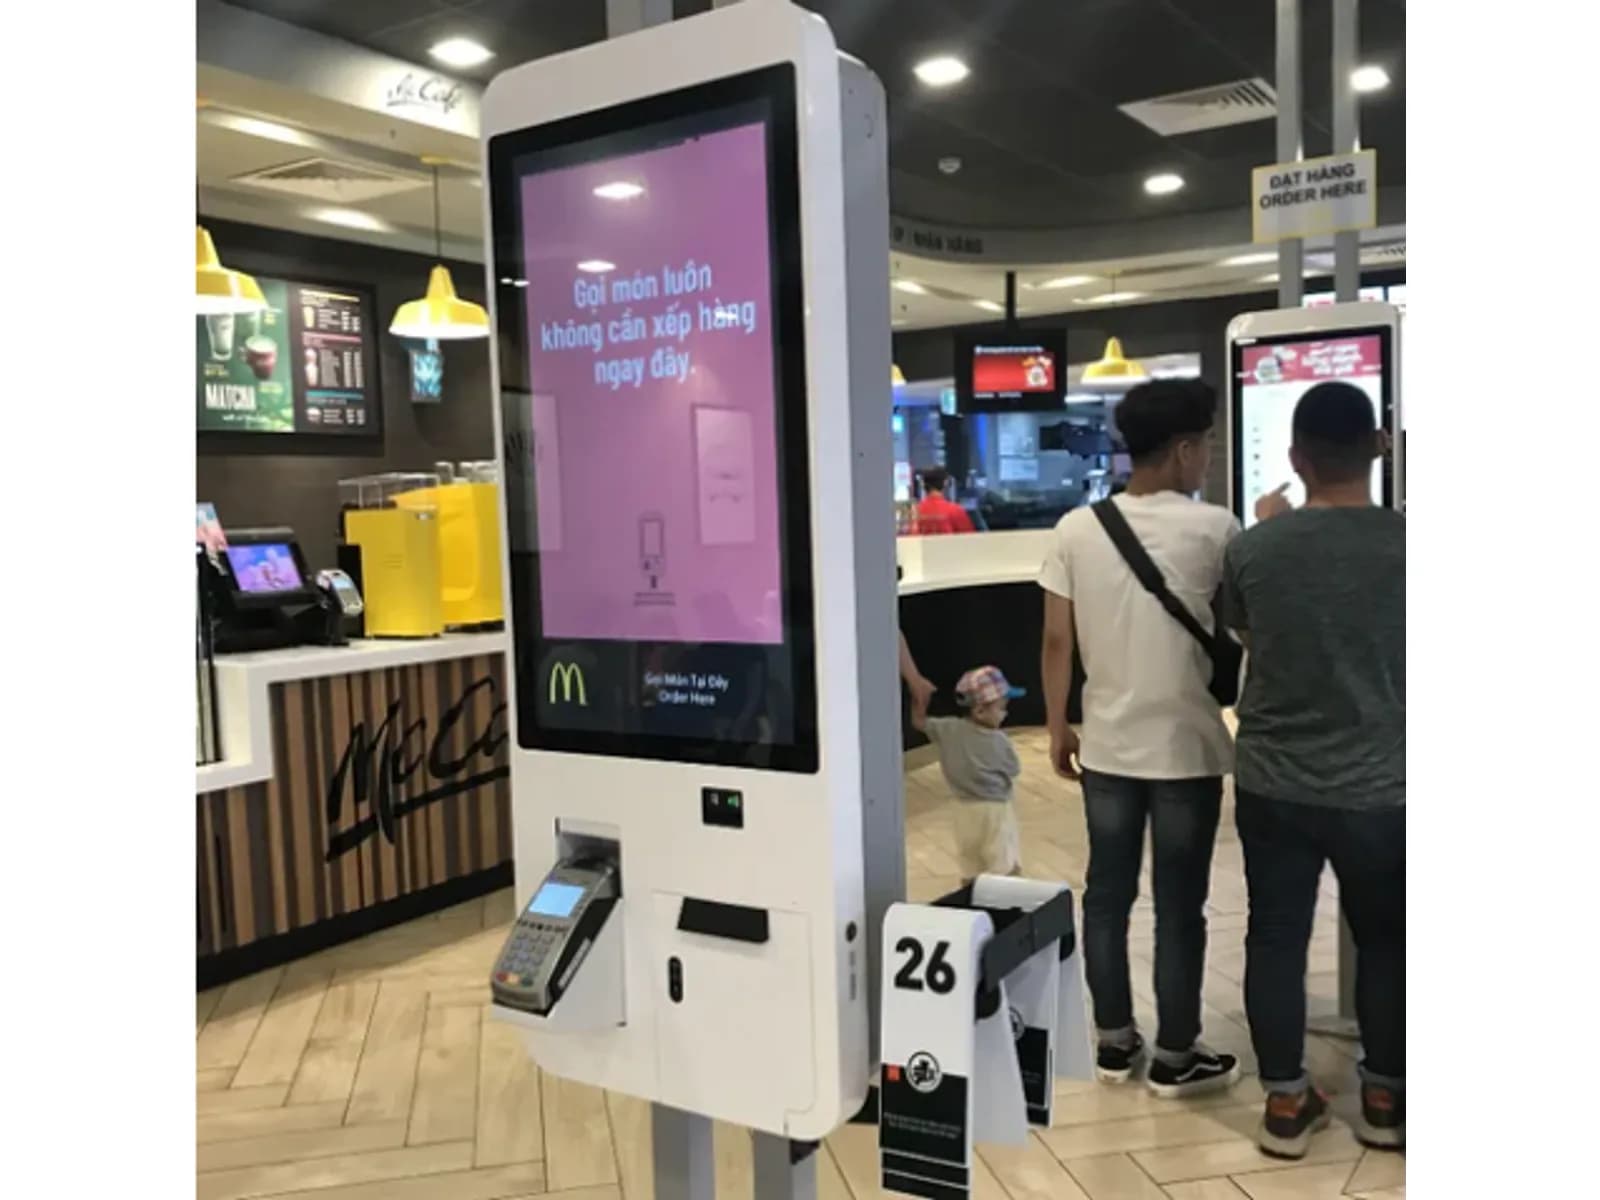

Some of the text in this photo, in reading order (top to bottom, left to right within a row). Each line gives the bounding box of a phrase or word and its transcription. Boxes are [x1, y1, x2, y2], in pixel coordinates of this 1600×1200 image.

[1260, 179, 1367, 210] ORDER HERE
[574, 259, 712, 314] Gọi món luôn
[541, 298, 756, 353] không cần xếp hàng
[595, 357, 644, 390] ngay
[659, 690, 688, 704] Order
[893, 936, 956, 995] 26
